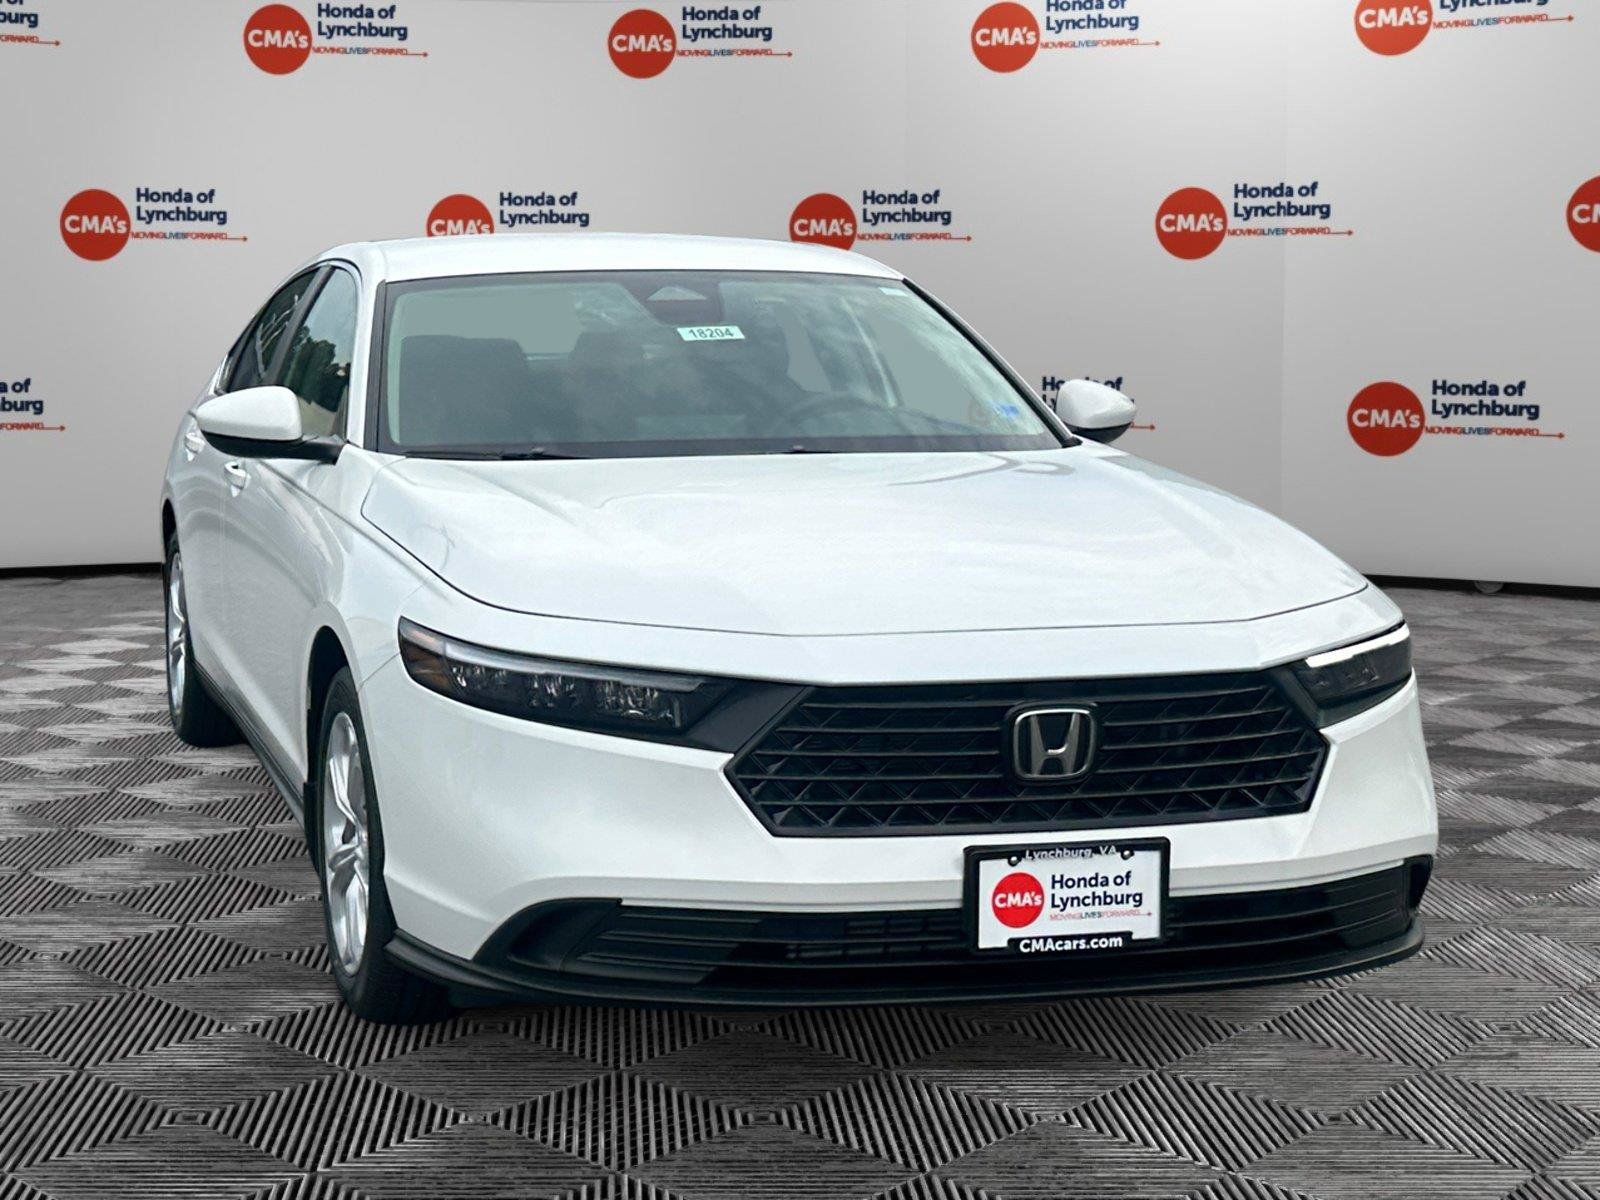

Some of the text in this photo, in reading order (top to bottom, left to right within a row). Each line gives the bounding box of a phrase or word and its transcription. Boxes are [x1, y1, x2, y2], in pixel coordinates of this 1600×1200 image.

[317, 4, 396, 19] Honda of
[682, 6, 761, 20] Honda of
[1046, 0, 1126, 11] Honda of
[1046, 14, 1139, 34] Lynchburg
[1359, 7, 1429, 29] CMA's
[247, 29, 308, 48] CMA's
[317, 22, 408, 40] Lynchburg
[682, 24, 773, 42] Lynchburg
[975, 27, 1037, 47] CMA's
[611, 34, 673, 52] CMA's
[136, 187, 216, 203] Honda of
[499, 191, 578, 206] Honda of
[863, 190, 941, 205] Honda of
[1233, 181, 1318, 199] Honda of
[136, 206, 228, 225] Lynchburg
[499, 210, 590, 227] Lynchburg
[863, 208, 952, 226] Lynchburg
[1233, 201, 1331, 220] Lynchburg
[64, 215, 127, 233] CMA's
[431, 219, 491, 236] CMA's
[794, 218, 853, 236] CMA's
[1160, 213, 1223, 232] CMA's
[689, 328, 735, 338] 18204
[11, 378, 31, 393] of
[1432, 380, 1526, 396] Honda of
[1352, 409, 1420, 428] CMA's
[1432, 400, 1540, 420] Lynchburg
[1099, 845, 1117, 855] VA
[1051, 871, 1132, 889] Honda of
[994, 893, 1042, 908] CMA's
[1051, 891, 1143, 912] Lynchburg
[1019, 935, 1123, 953] CMAcars.com
